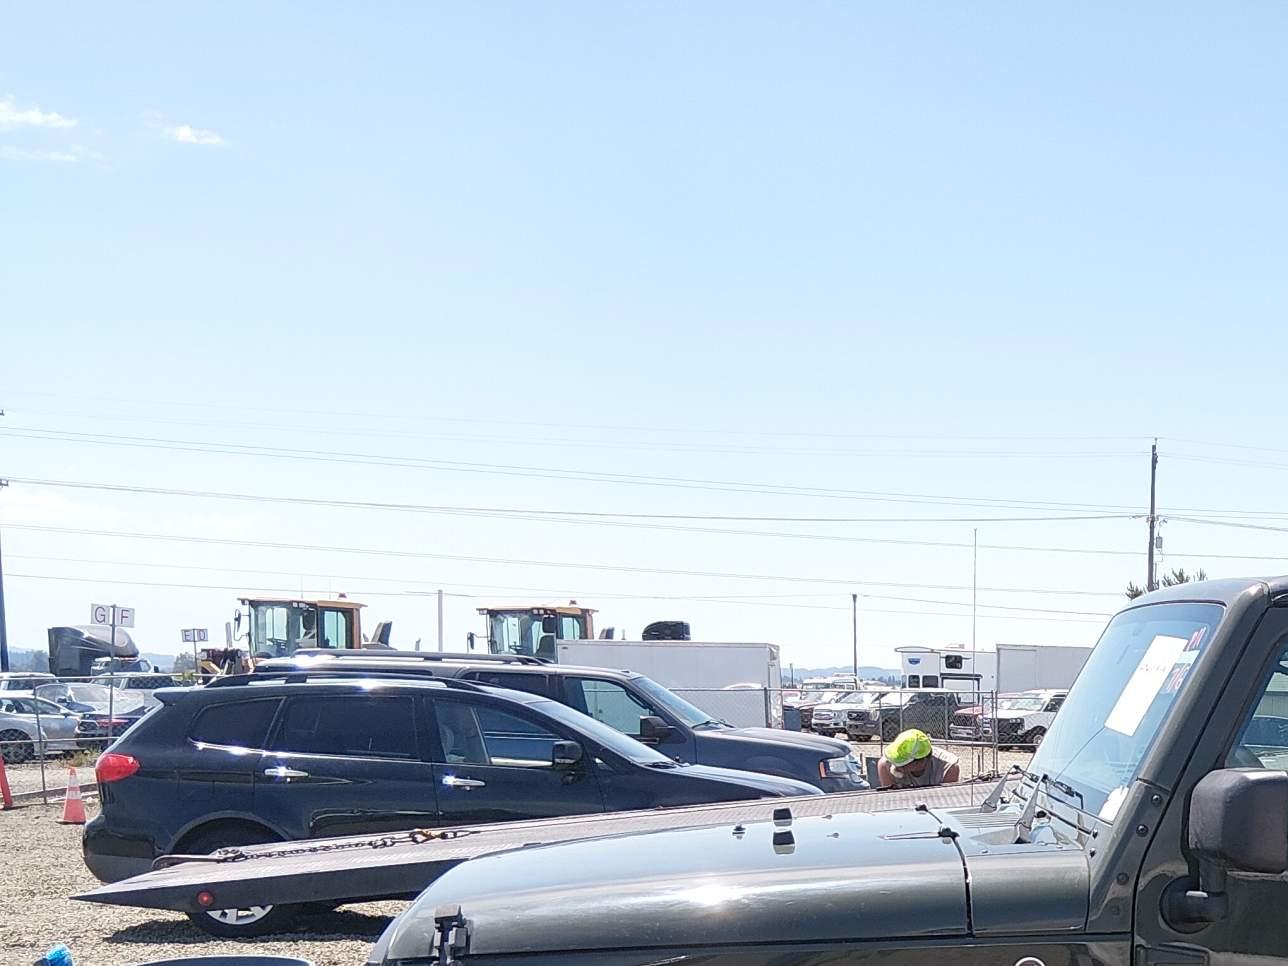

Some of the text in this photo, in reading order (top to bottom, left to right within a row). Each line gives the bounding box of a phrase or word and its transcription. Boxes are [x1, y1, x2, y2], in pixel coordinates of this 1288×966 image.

[94, 606, 106, 623] G
[120, 609, 129, 625] F
[184, 630, 191, 641] E
